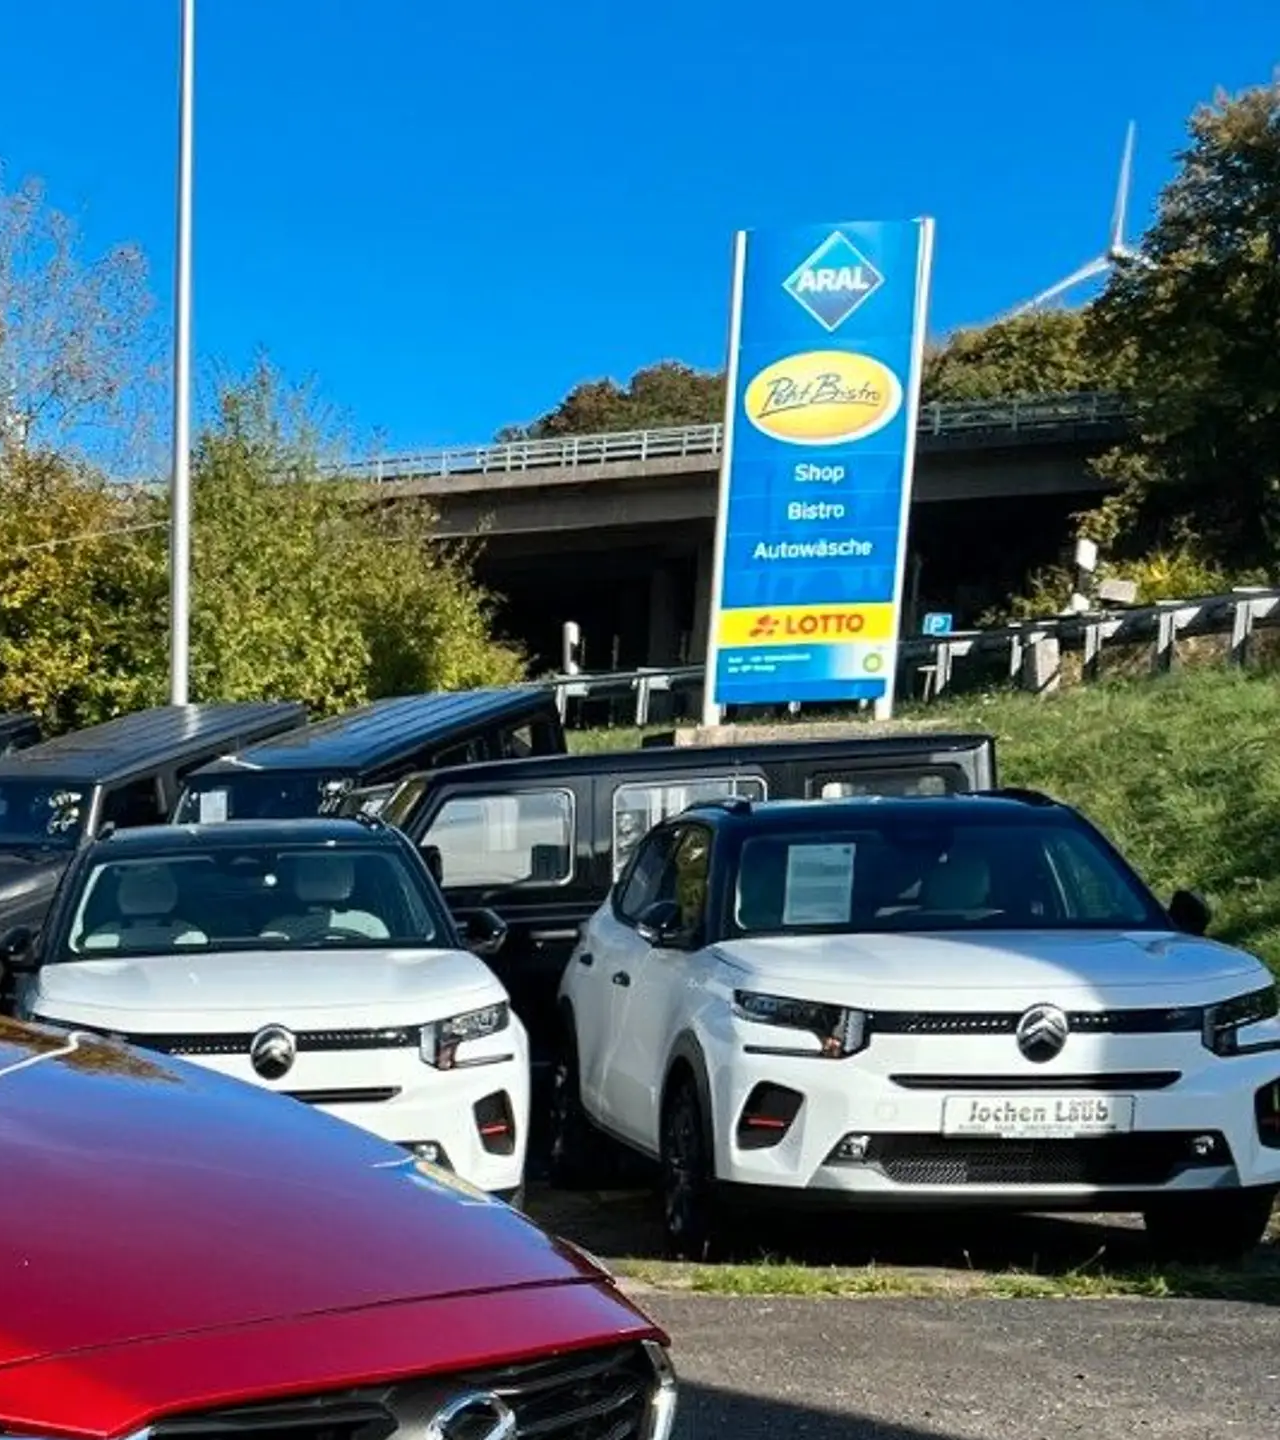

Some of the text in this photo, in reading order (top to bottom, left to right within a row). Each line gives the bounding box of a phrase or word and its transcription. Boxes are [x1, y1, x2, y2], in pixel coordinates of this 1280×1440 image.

[797, 266, 870, 293] ARAL
[811, 373, 882, 404] Bistro
[794, 463, 845, 485] Shop
[787, 501, 845, 520] Bistro
[752, 538, 873, 560] Autowäsche
[785, 613, 865, 635] LOTTO
[968, 1101, 1046, 1123] Jochen
